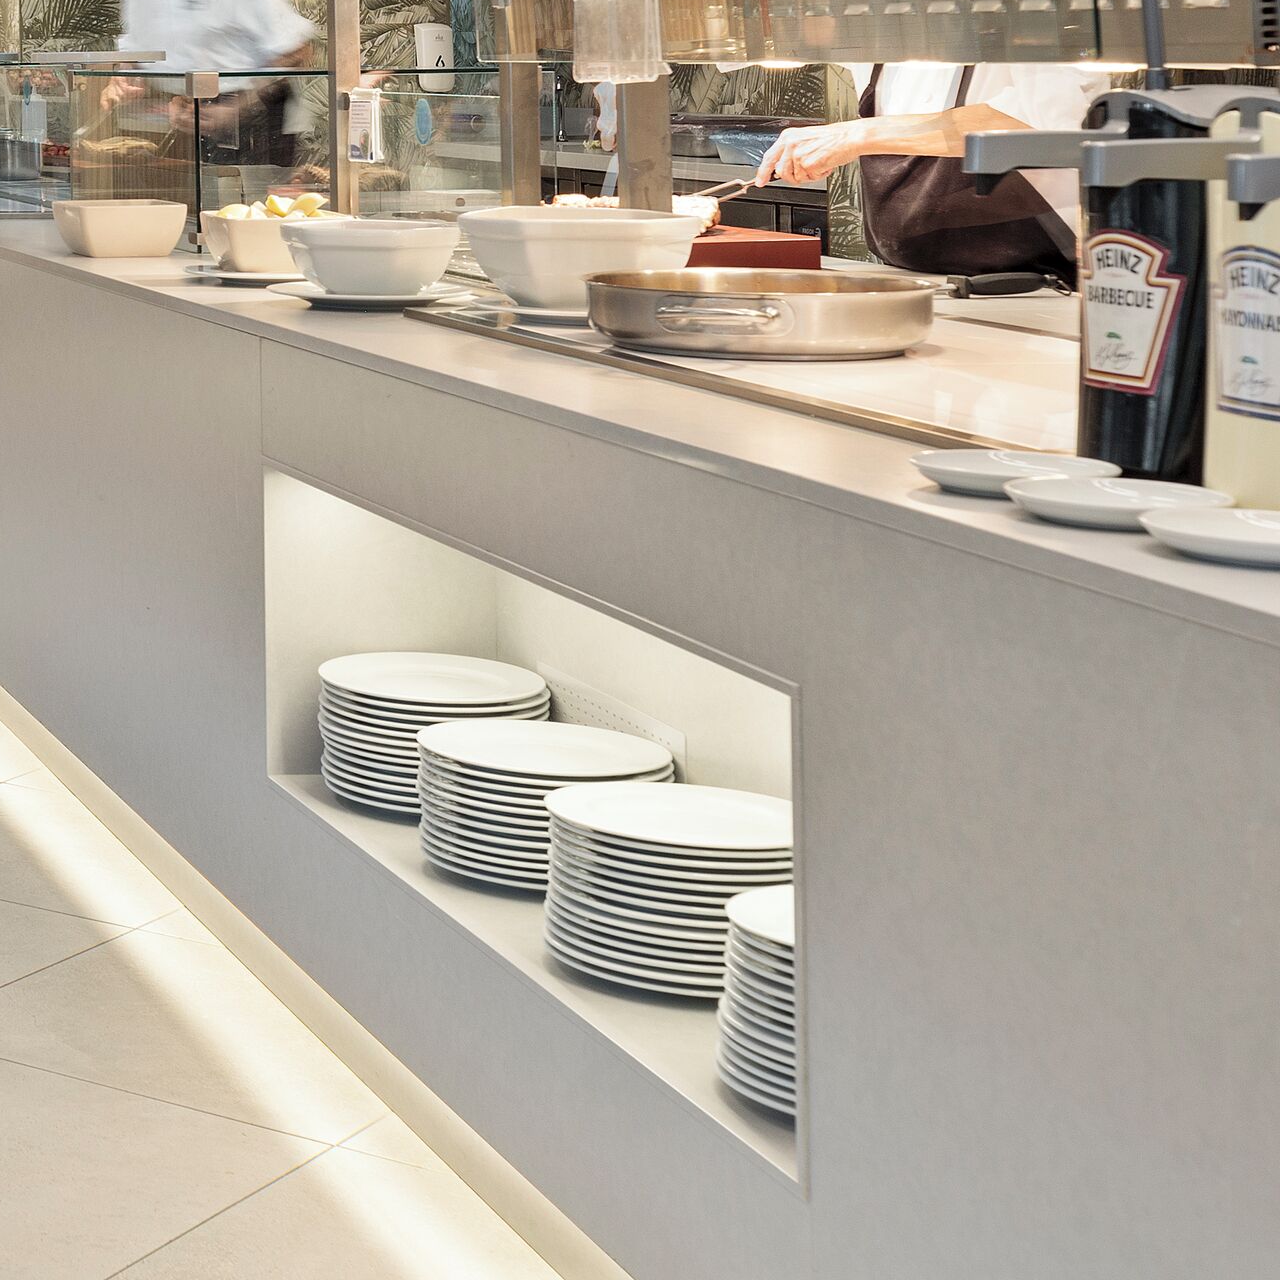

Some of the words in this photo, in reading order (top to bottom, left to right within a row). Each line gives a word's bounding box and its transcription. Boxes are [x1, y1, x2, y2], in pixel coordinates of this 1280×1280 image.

[1095, 248, 1143, 274] HEINZ
[1230, 266, 1280, 295] HEINZ
[1088, 285, 1154, 309] BARBECUE
